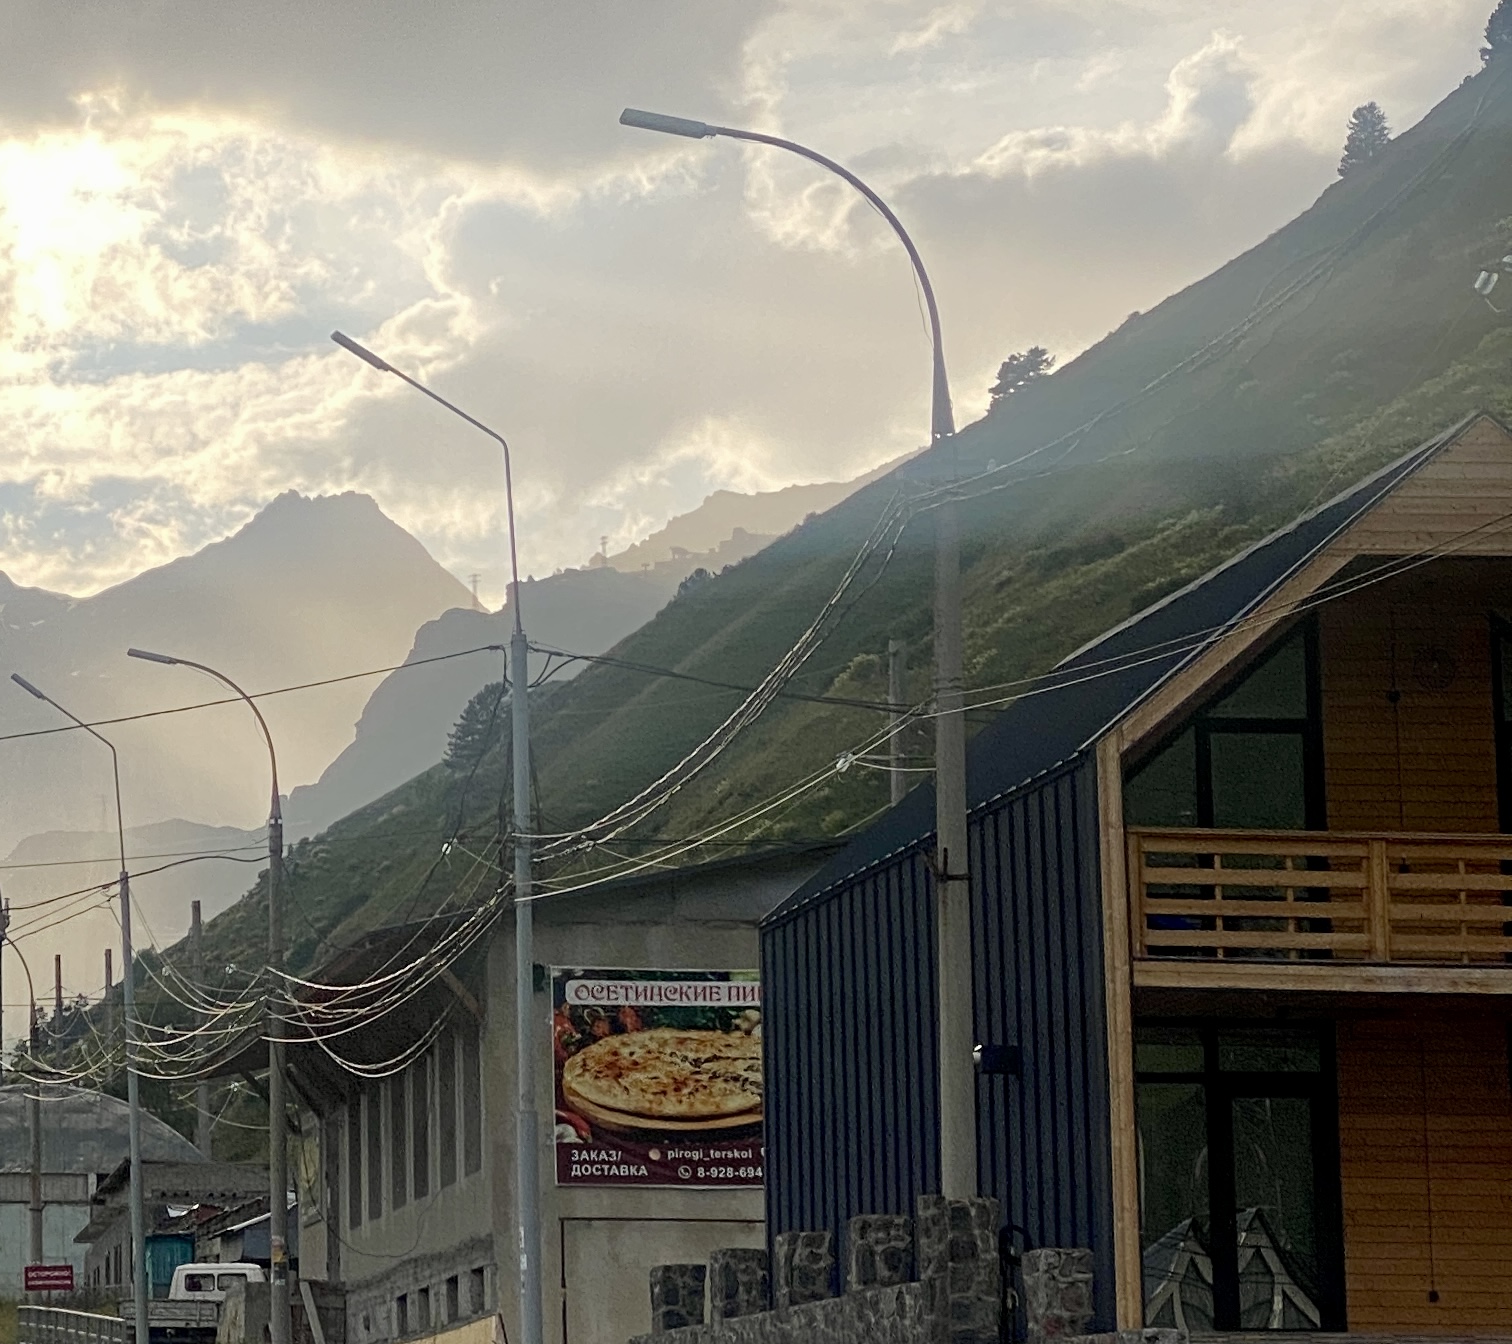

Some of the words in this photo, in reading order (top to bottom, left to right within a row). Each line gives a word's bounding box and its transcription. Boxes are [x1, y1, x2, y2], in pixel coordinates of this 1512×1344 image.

[574, 984, 722, 1002] ОСЕТИНСКИЕ
[571, 1149, 622, 1162] ЗАКАЗ/
[571, 1164, 648, 1177] ДОСТАВКА
